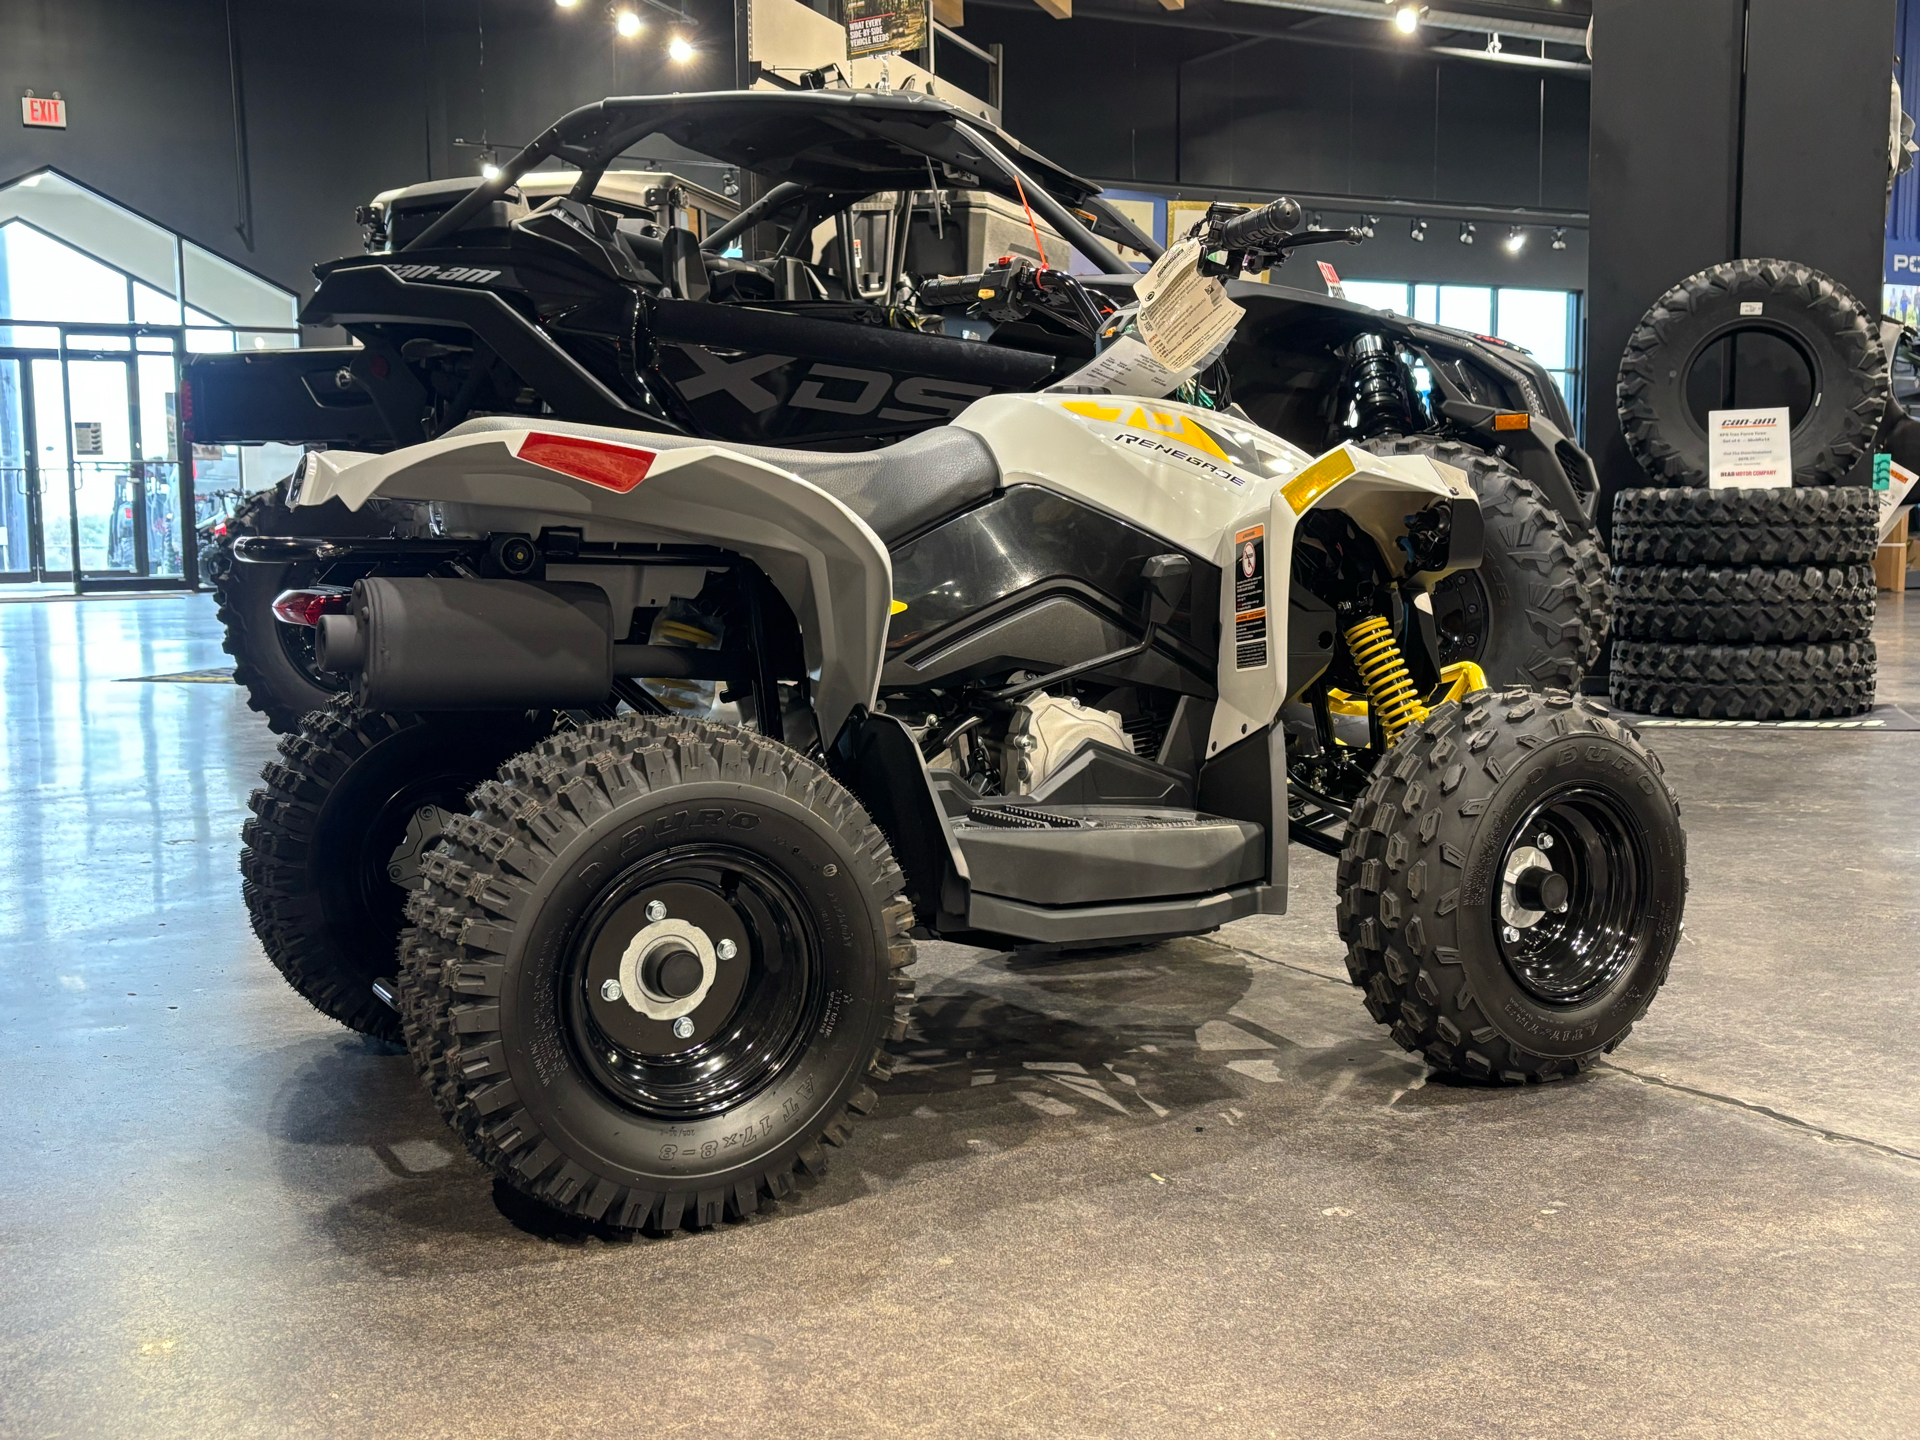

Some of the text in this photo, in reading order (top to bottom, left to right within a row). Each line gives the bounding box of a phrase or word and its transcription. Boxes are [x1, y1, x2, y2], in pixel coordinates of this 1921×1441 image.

[849, 18, 882, 31] WHAT EVERY
[850, 26, 883, 39] SIDE-BY-SIDE
[850, 33, 890, 47] VEHICLE NEEDS
[30, 99, 59, 123] EXIT
[675, 342, 993, 422] XDS
[1721, 418, 1777, 426] can-am
[1114, 434, 1246, 487] RENEGADE
[1556, 745, 1657, 795] DURO
[619, 808, 762, 859] DURO
